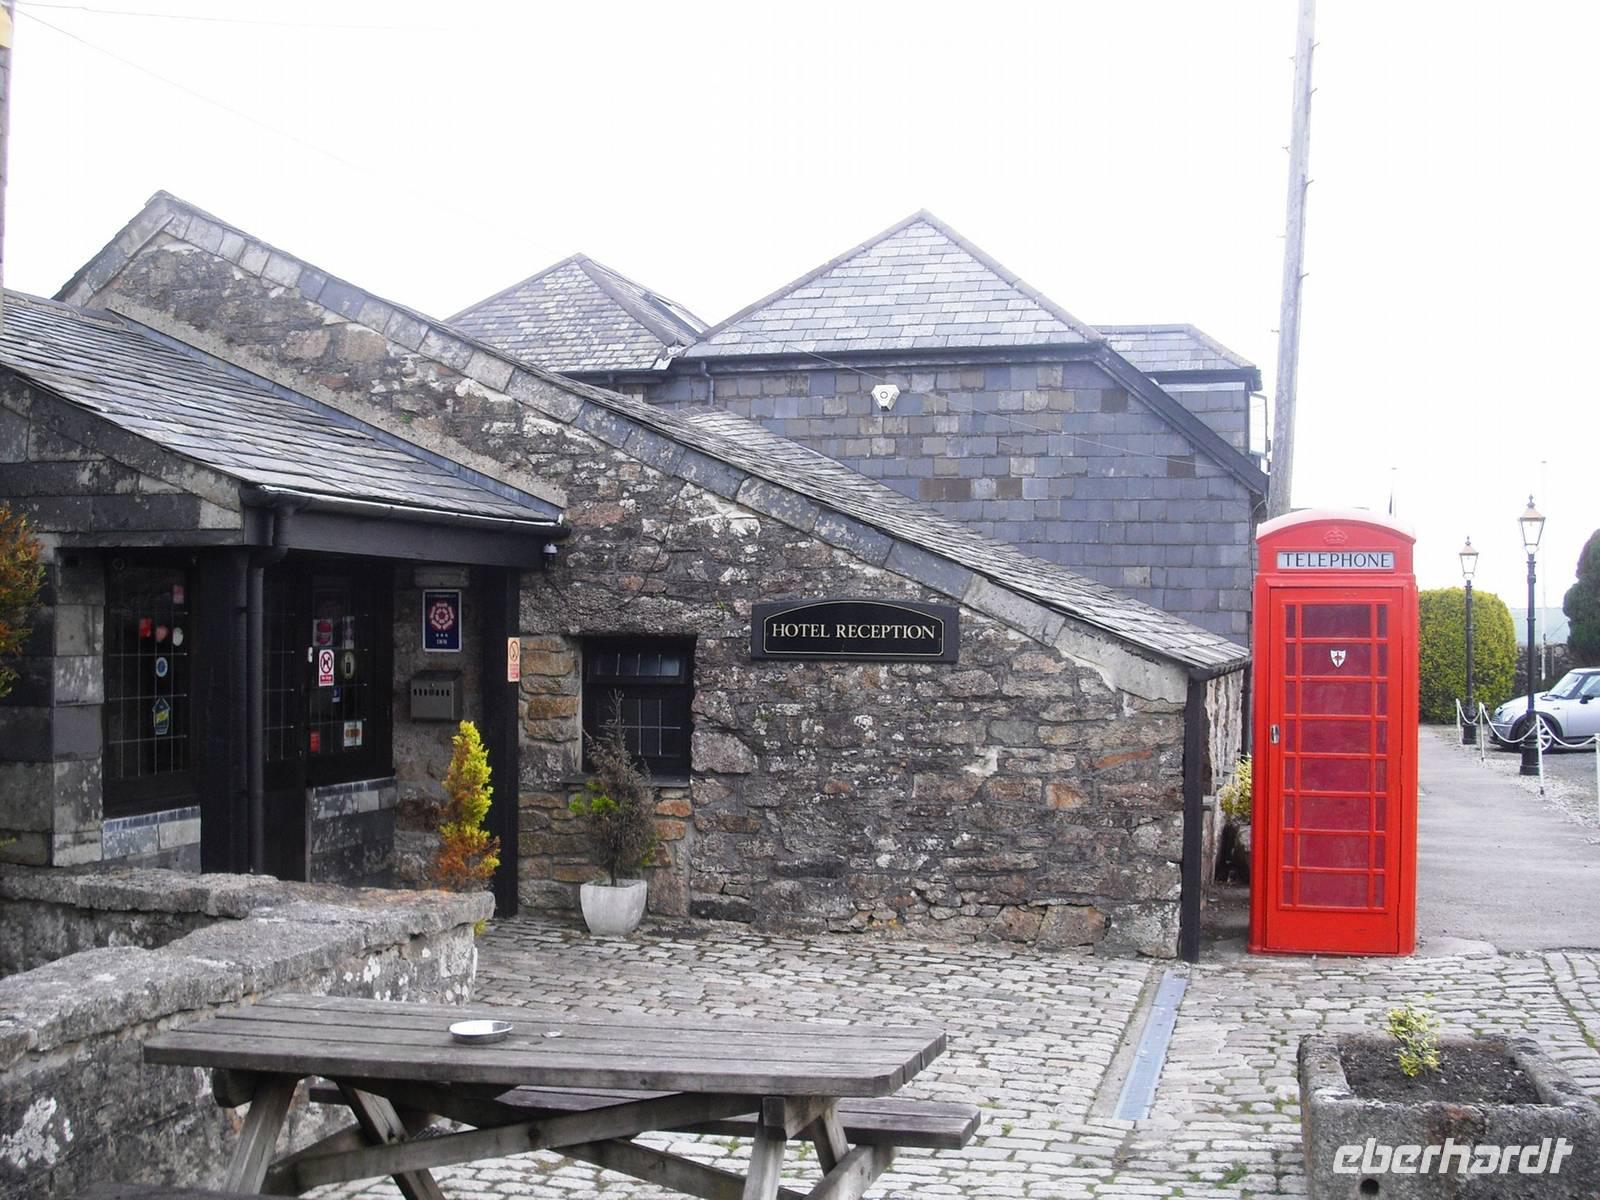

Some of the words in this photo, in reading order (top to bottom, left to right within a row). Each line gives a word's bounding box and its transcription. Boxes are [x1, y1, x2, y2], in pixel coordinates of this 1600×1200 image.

[1282, 552, 1391, 568] TELEPHONE
[772, 623, 830, 638] HOTEL
[836, 624, 936, 640] RECEPTION
